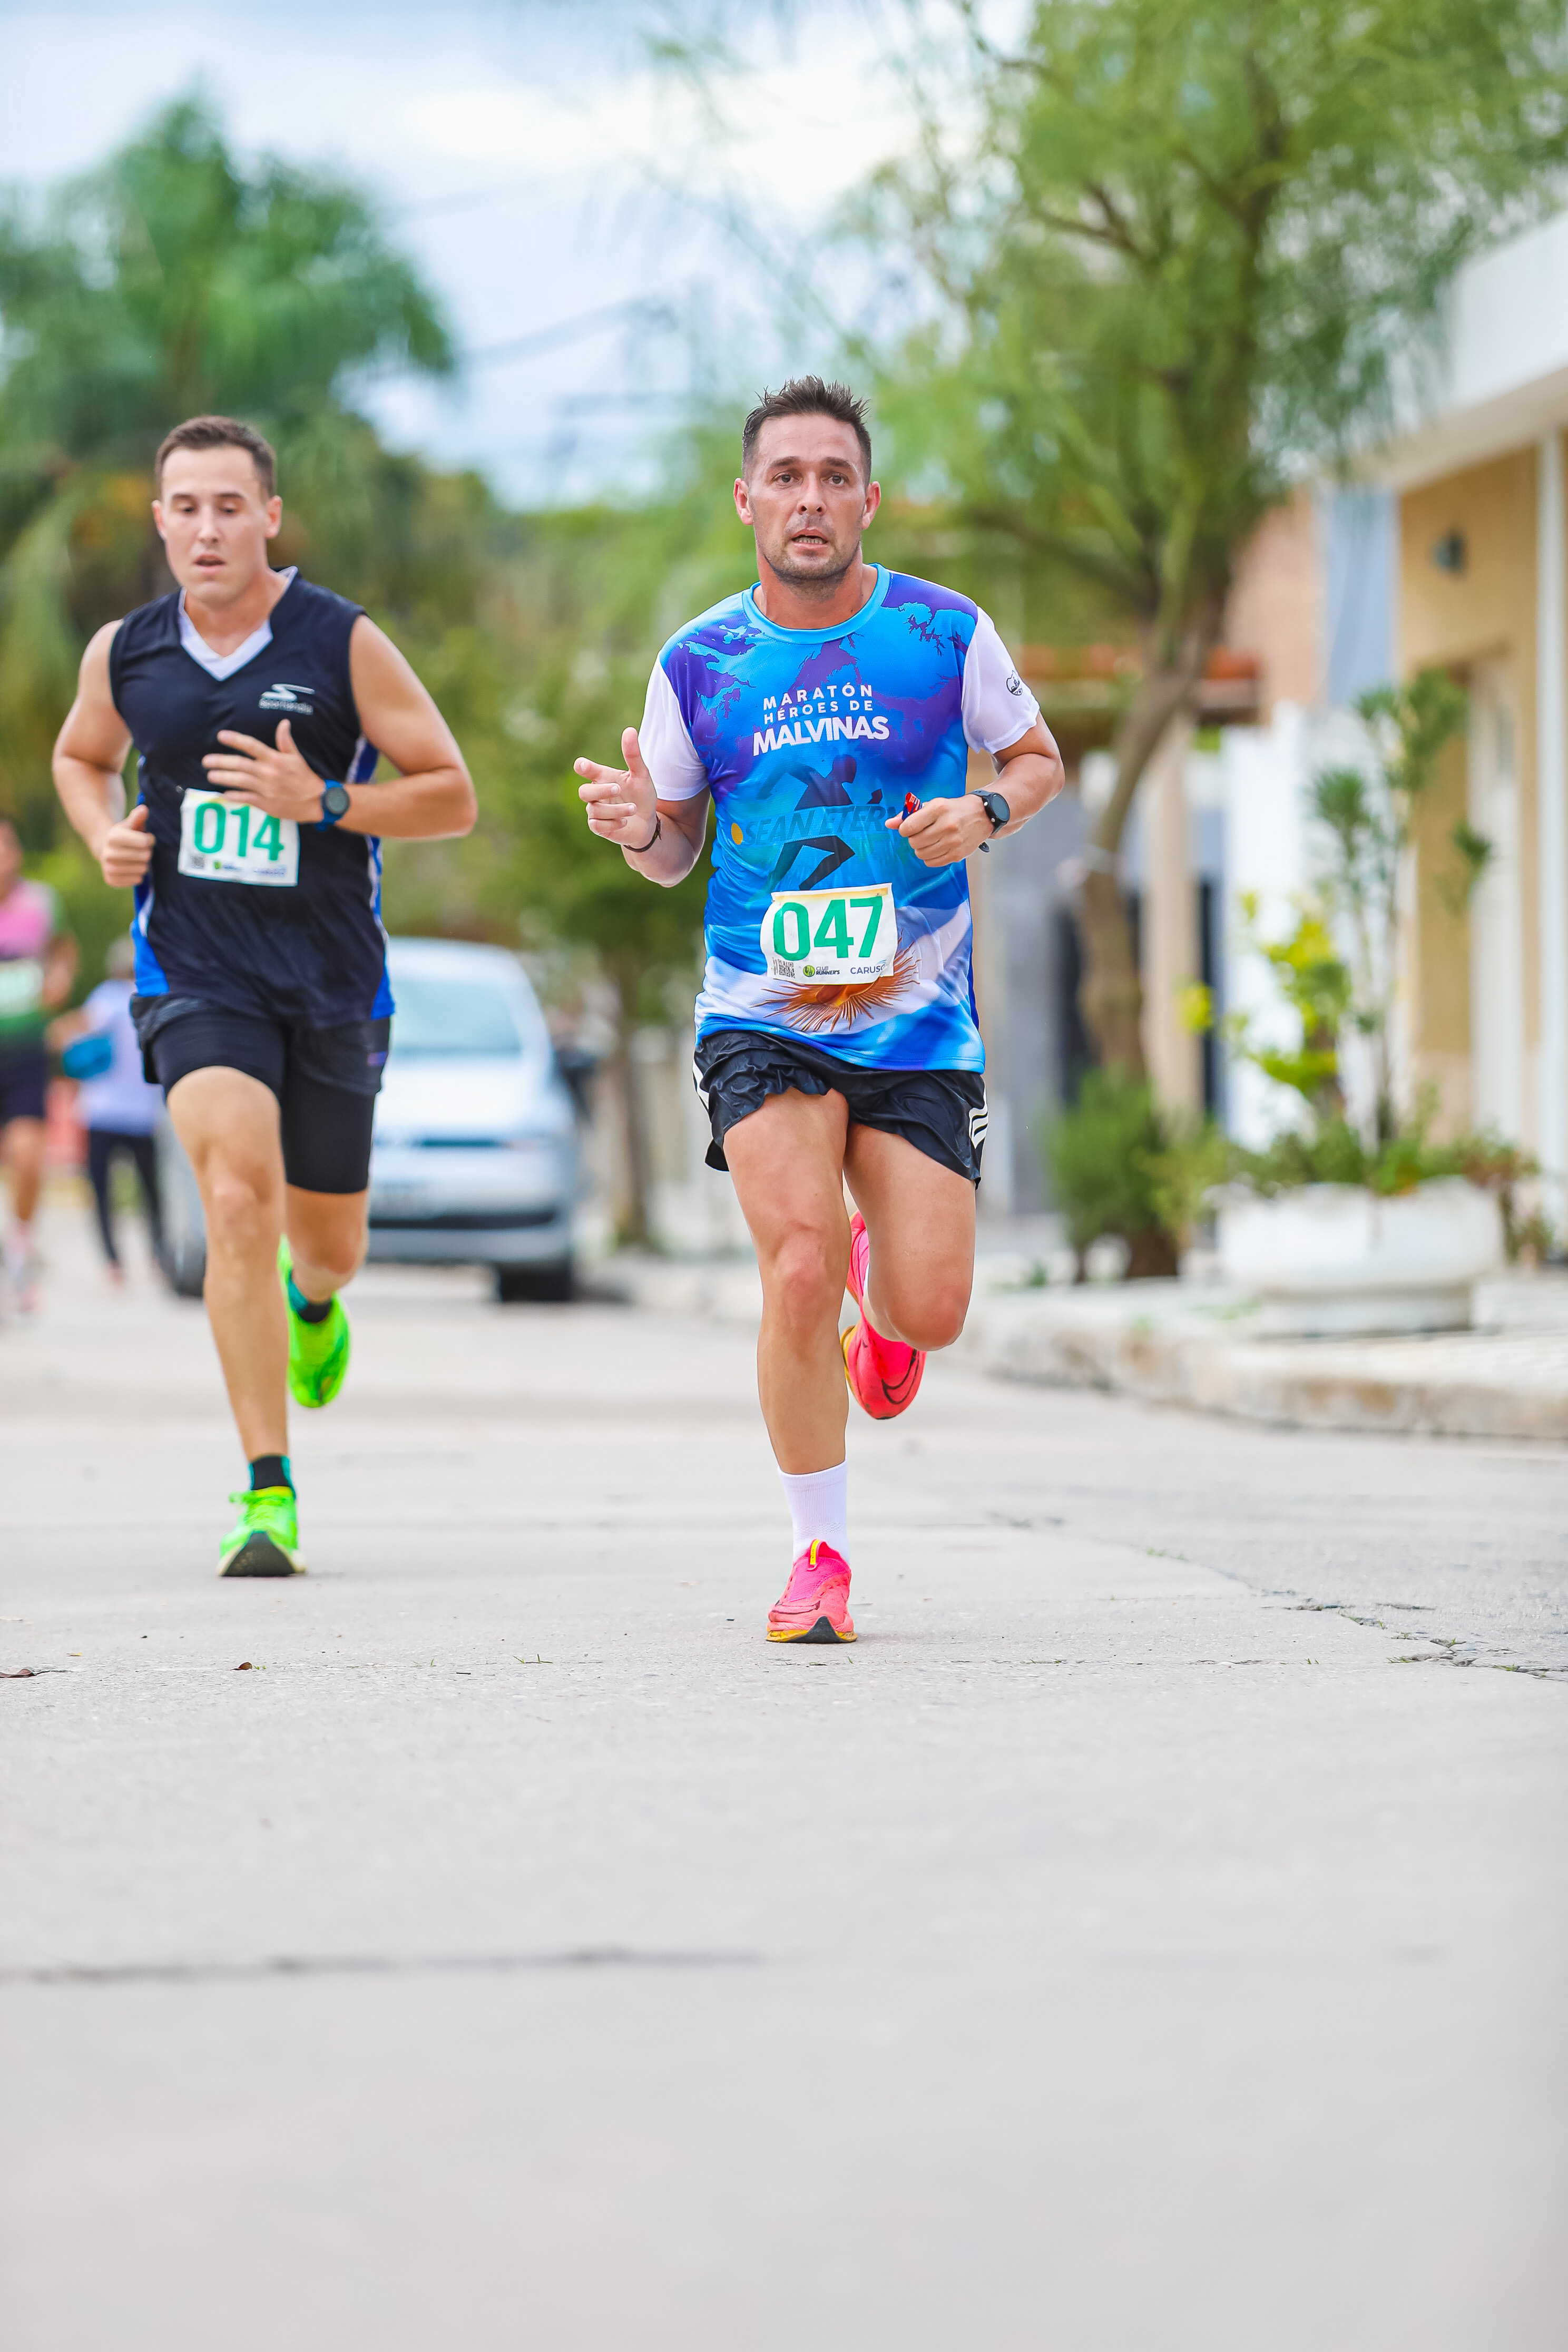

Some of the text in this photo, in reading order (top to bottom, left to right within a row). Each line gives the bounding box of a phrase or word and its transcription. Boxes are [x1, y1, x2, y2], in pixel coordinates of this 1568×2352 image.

[763, 682, 872, 711] MARATÓN
[764, 700, 873, 725] HÉROES DE
[753, 716, 890, 756] MALVINAS
[194, 802, 284, 861] 014
[773, 896, 883, 961] 047
